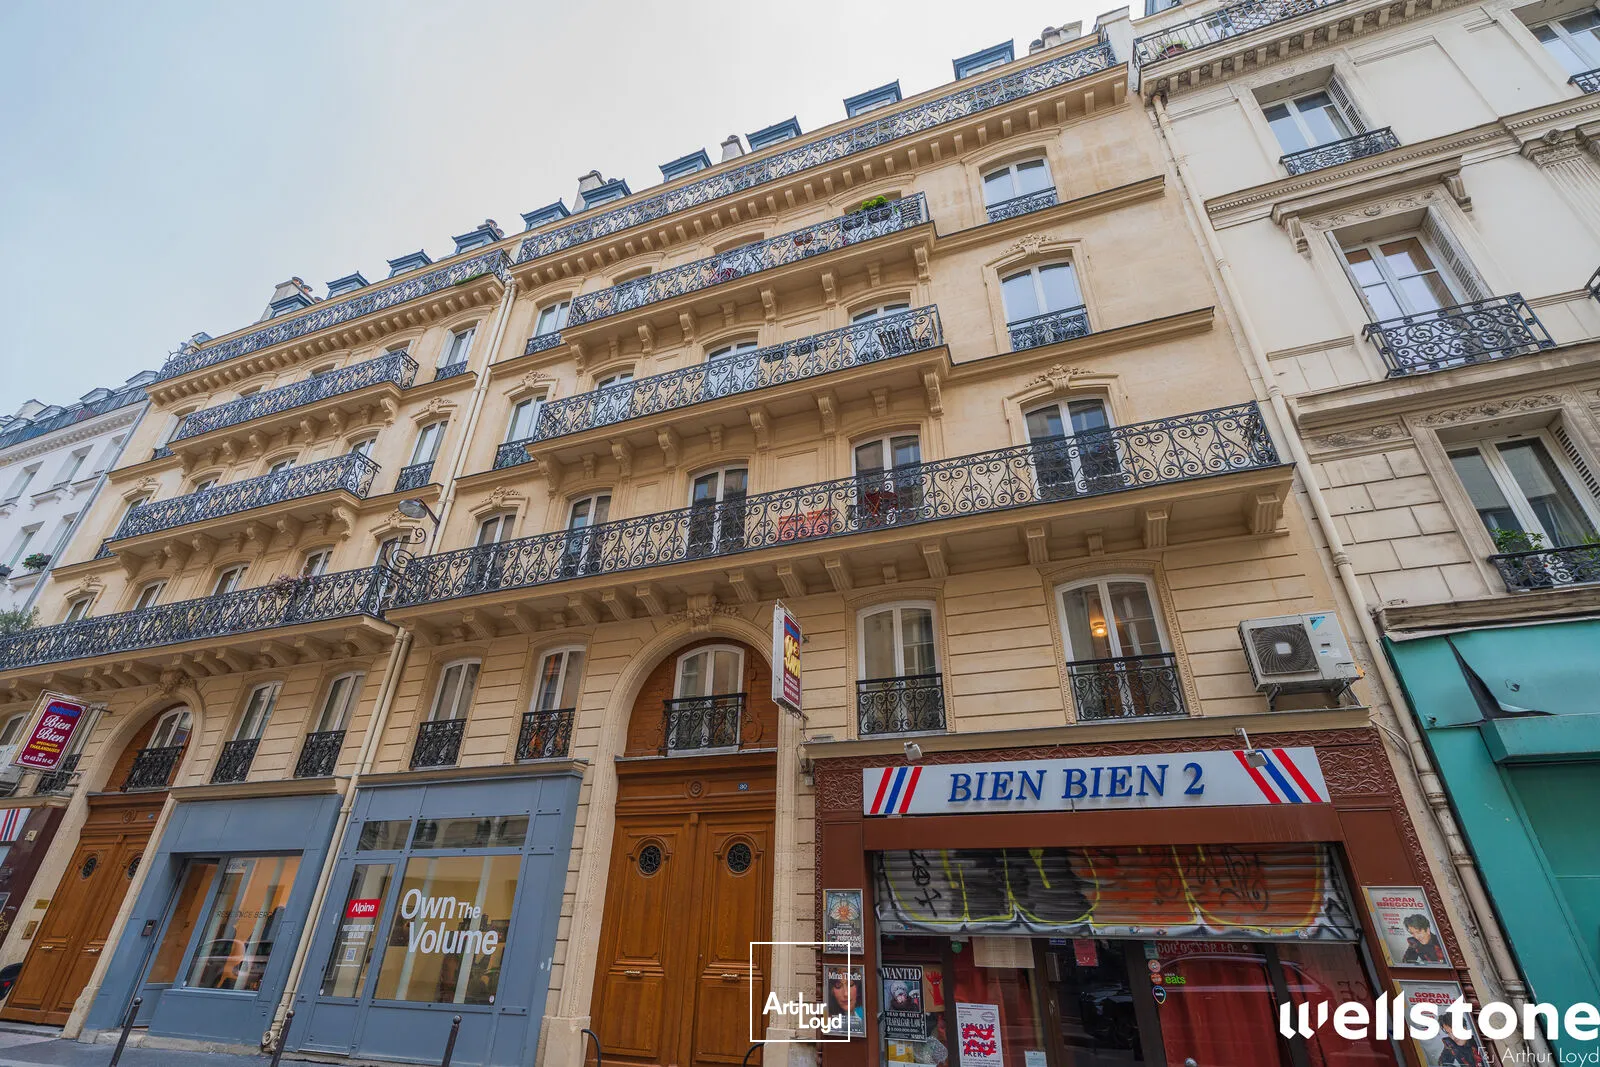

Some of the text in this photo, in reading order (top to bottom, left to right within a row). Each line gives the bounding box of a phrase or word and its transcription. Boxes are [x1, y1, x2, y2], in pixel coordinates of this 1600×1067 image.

[43, 714, 71, 730] Bien
[36, 727, 65, 742] Bien
[947, 762, 1205, 802] BIEN BIEN 2
[351, 902, 375, 914] Alpine
[401, 888, 481, 920] Own The
[408, 921, 499, 955] Volume
[881, 967, 922, 980] WANTED
[1164, 975, 1187, 985] eats
[1414, 991, 1450, 999] GORAN
